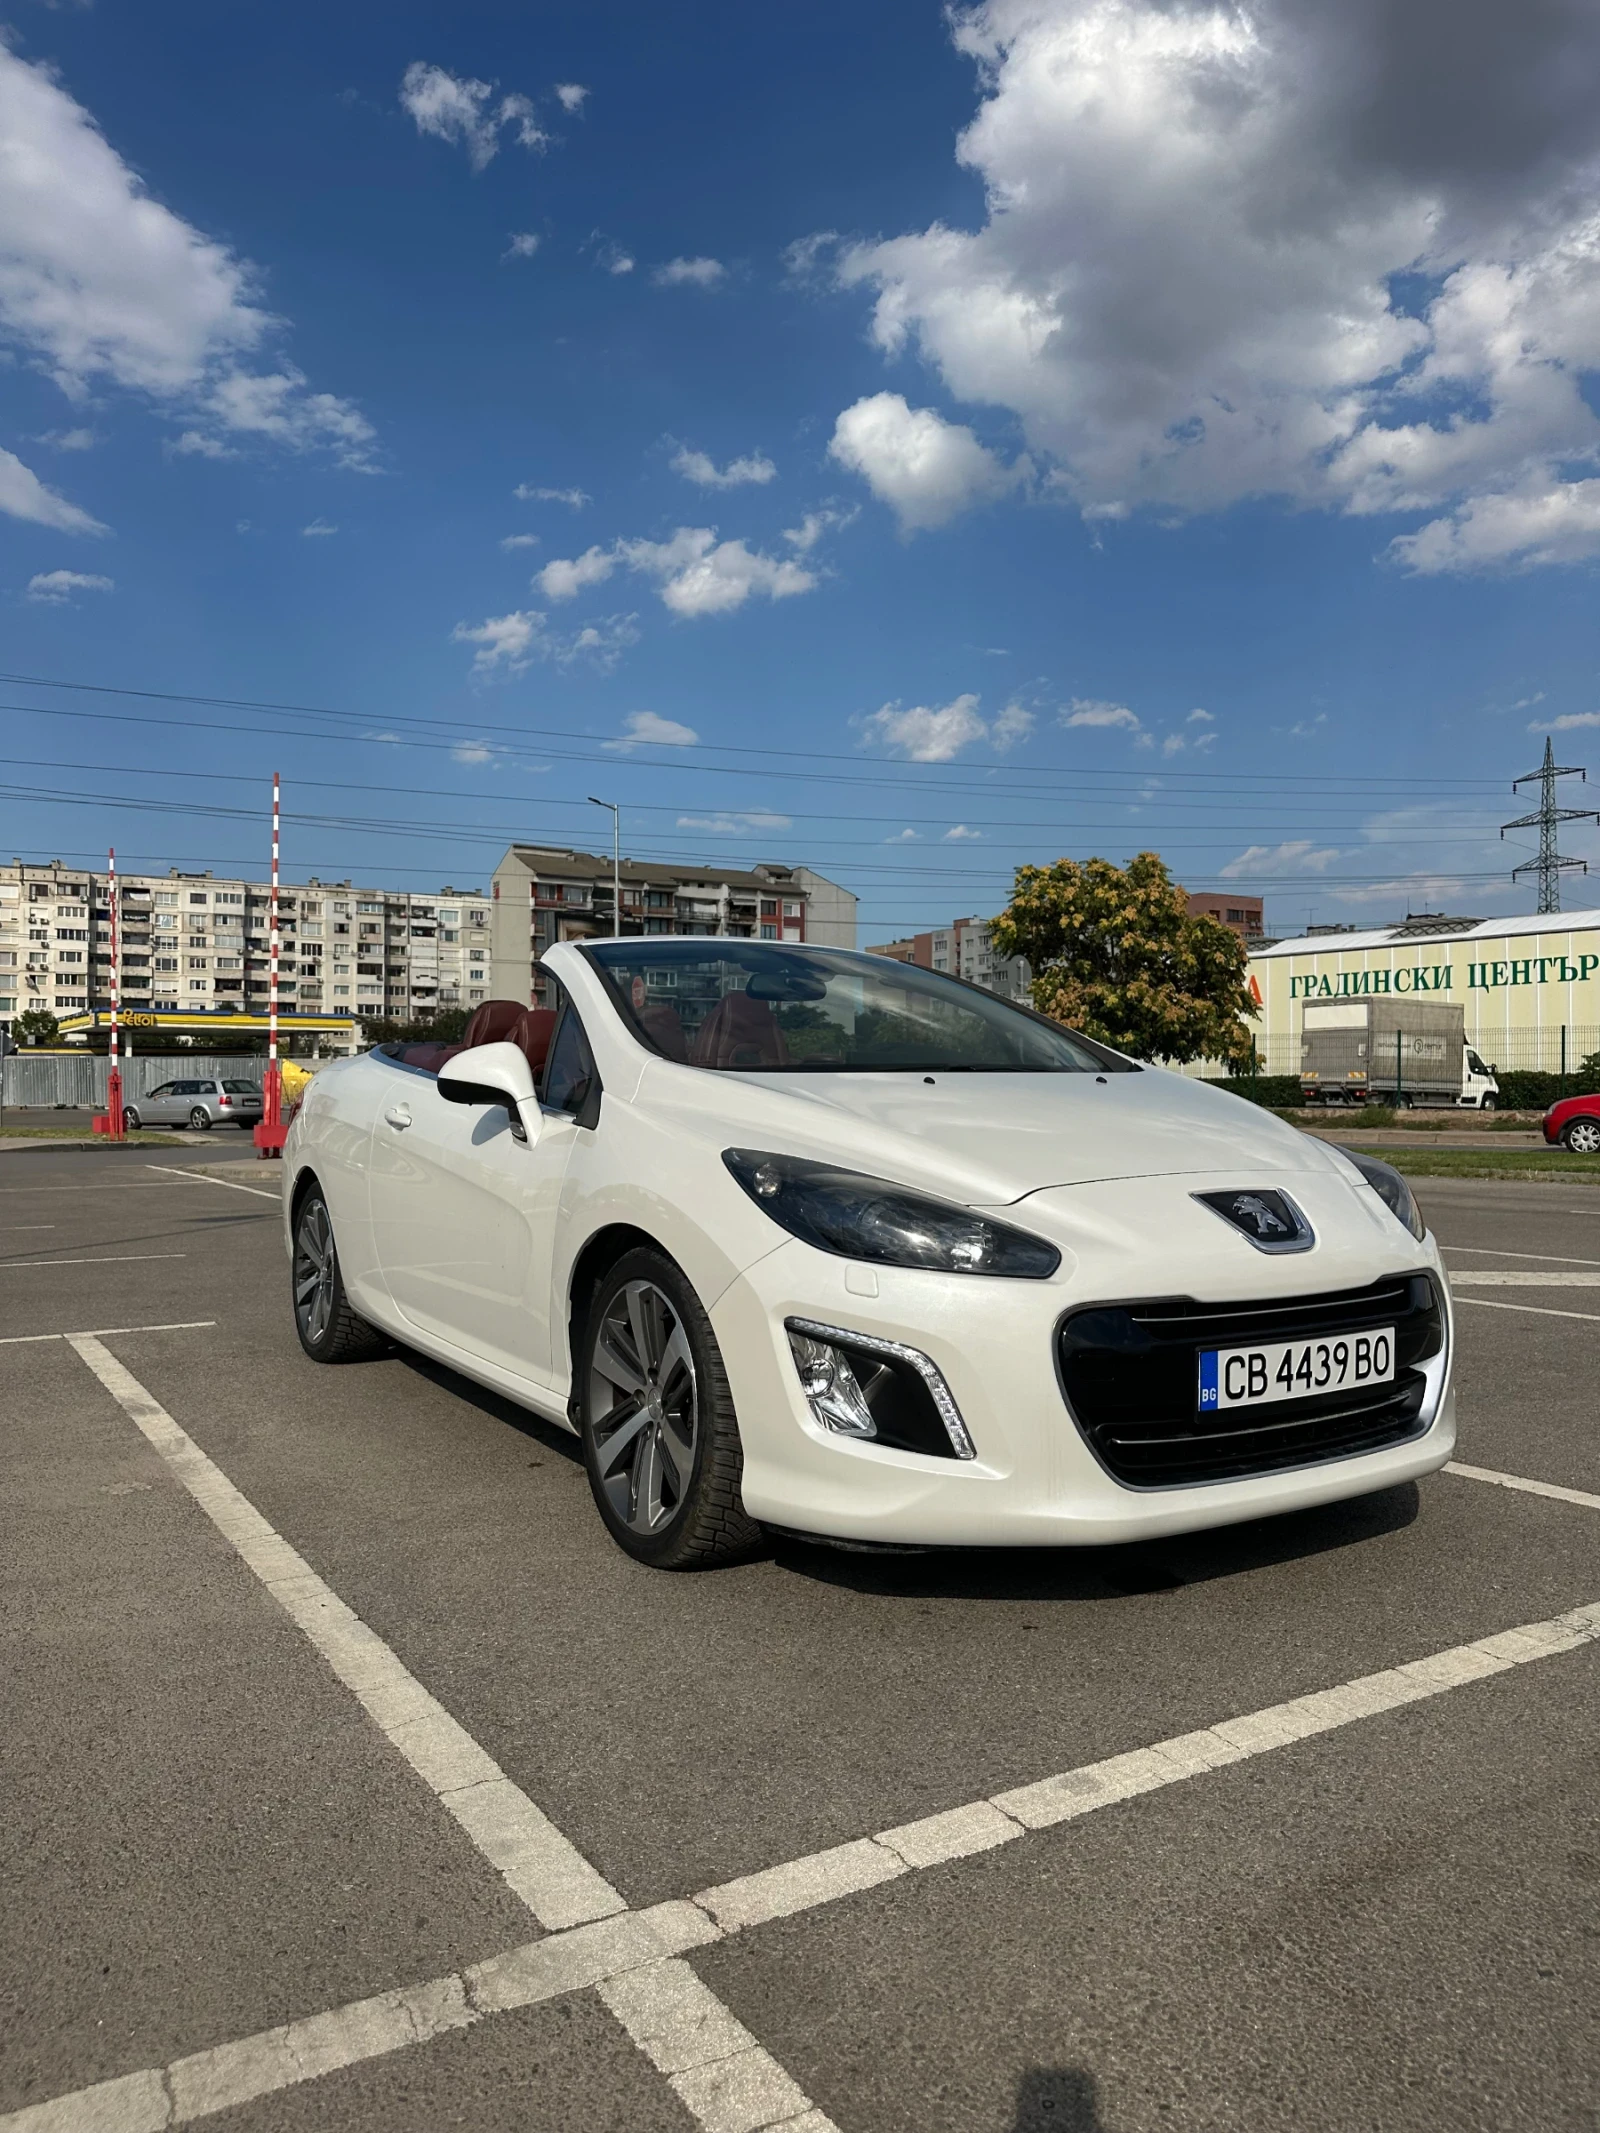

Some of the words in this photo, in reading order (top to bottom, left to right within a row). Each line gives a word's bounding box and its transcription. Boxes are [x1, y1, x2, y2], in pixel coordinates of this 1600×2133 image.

[1289, 964, 1454, 999] ГРАДИНСКИ
[1467, 954, 1600, 994] ЦЕНТЪР
[1224, 1352, 1268, 1400] CB
[1275, 1342, 1349, 1393] 4439
[1355, 1335, 1390, 1381] BO
[1201, 1387, 1217, 1402] BG
